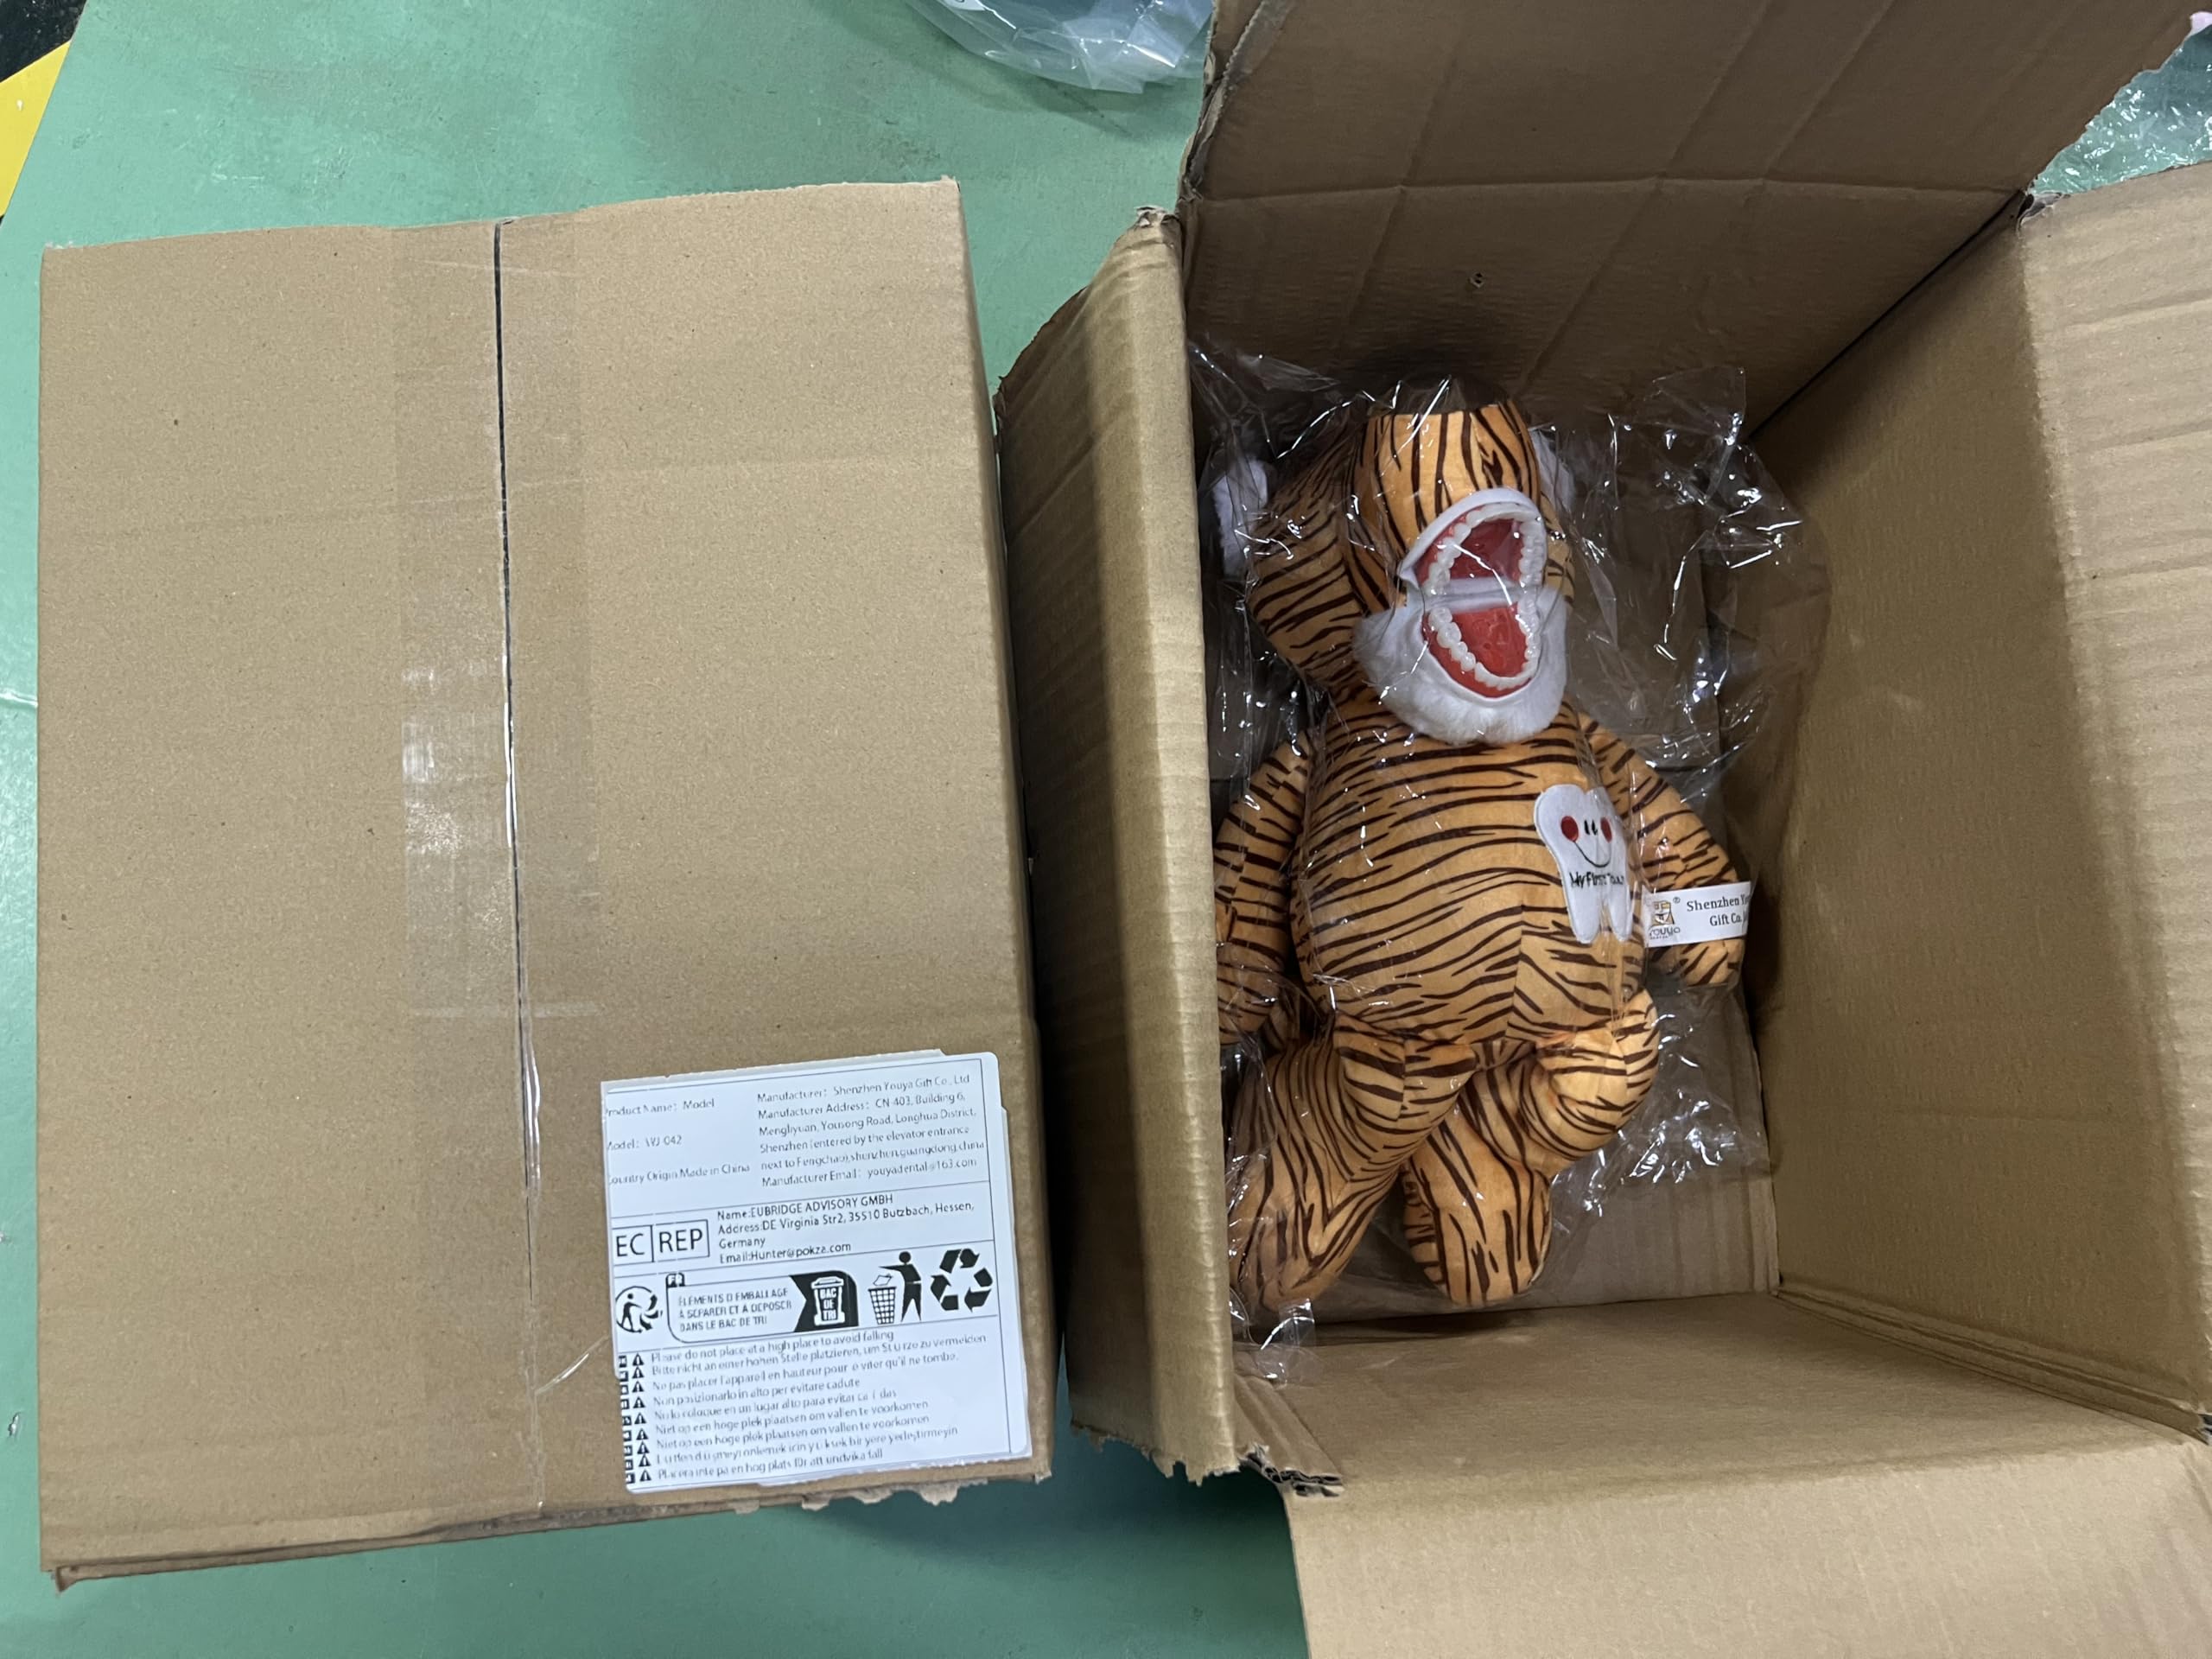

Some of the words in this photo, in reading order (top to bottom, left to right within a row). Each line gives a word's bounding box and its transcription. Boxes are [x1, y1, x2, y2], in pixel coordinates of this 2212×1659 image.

[1687, 896, 1739, 912] Shenzhen
[1709, 913, 1730, 926] Gift
[833, 1083, 881, 1096] Shenzhen
[884, 1080, 913, 1092] Youya
[915, 1077, 932, 1089] Gift
[683, 1098, 715, 1110] Model
[758, 1107, 823, 1121] Manufacturer
[915, 1092, 955, 1105] Building
[866, 1115, 893, 1127] Road,
[895, 1112, 938, 1125] Longhua
[760, 1140, 808, 1154] Shenzhen
[854, 1135, 866, 1147] by
[868, 1132, 884, 1143] the
[886, 1128, 926, 1141] elevator
[927, 1125, 969, 1137] entrance
[680, 1166, 709, 1179] Made
[709, 1166, 720, 1176] in
[760, 1160, 782, 1171] next
[785, 1158, 796, 1169] to
[761, 1173, 828, 1187] Manufacturer
[804, 1196, 858, 1212] ADVISORY
[861, 1193, 893, 1207] GMBH
[779, 1215, 820, 1231] Virginia
[848, 1210, 880, 1223] 35510
[935, 1200, 976, 1214] Hessen,
[615, 1232, 645, 1257] EC
[658, 1228, 703, 1254] REP
[718, 1236, 766, 1249] Germany
[820, 1287, 837, 1299] BAC
[823, 1299, 836, 1309] DE
[679, 1320, 704, 1332] DANS
[705, 1319, 716, 1331] LE
[718, 1318, 737, 1330] BAC
[739, 1315, 751, 1327] DE
[752, 1314, 768, 1325] TRI
[823, 1309, 838, 1321] TRI
[684, 1348, 698, 1360] do
[700, 1347, 717, 1358] not
[719, 1344, 745, 1359] place
[747, 1344, 758, 1354] at
[767, 1340, 791, 1354] high
[792, 1336, 819, 1351] place
[820, 1336, 832, 1346] to
[833, 1332, 861, 1345] avoid
[863, 1330, 895, 1342] falling
[703, 1362, 717, 1372] an
[863, 1344, 880, 1355] um
[919, 1340, 932, 1350] zu
[767, 1370, 781, 1381] en
[782, 1365, 823, 1380] hauteur
[823, 1363, 849, 1377] pour
[908, 1356, 921, 1366] ne
[738, 1388, 749, 1400] in
[749, 1386, 770, 1398] alto
[772, 1386, 788, 1399] per
[790, 1381, 825, 1394] evitare
[826, 1377, 861, 1390] cadute
[724, 1406, 736, 1415] en
[781, 1398, 801, 1410] alto
[803, 1397, 826, 1409] para
[827, 1392, 855, 1404] evitar
[713, 1418, 740, 1432] hoge
[741, 1414, 762, 1430] plek
[809, 1410, 825, 1421] om
[859, 1406, 869, 1417] te
[714, 1433, 741, 1446] hoge
[742, 1429, 764, 1445] plek
[810, 1425, 827, 1436] om
[828, 1421, 859, 1434] vallen
[860, 1421, 871, 1432] te
[864, 1434, 887, 1448] yere
[696, 1466, 715, 1478] inte
[731, 1465, 744, 1474] en
[768, 1458, 792, 1472] plats
[810, 1455, 823, 1467] att
[825, 1451, 867, 1465] undvika
